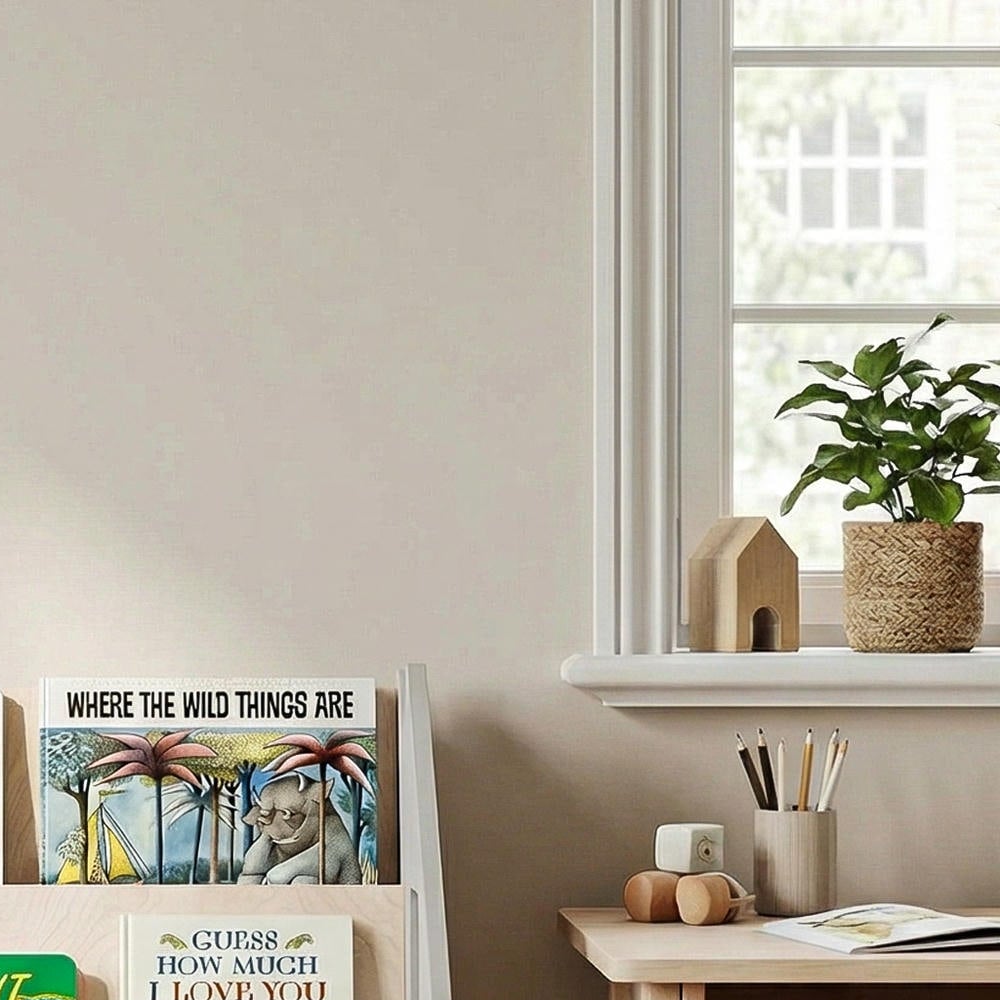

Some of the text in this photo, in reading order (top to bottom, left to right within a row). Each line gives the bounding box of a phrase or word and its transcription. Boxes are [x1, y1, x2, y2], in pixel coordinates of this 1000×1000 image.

[67, 691, 353, 718] WHERE THE WILD THINGS ARE
[191, 930, 278, 951] GUESS
[156, 955, 318, 976] HOW MUCH
